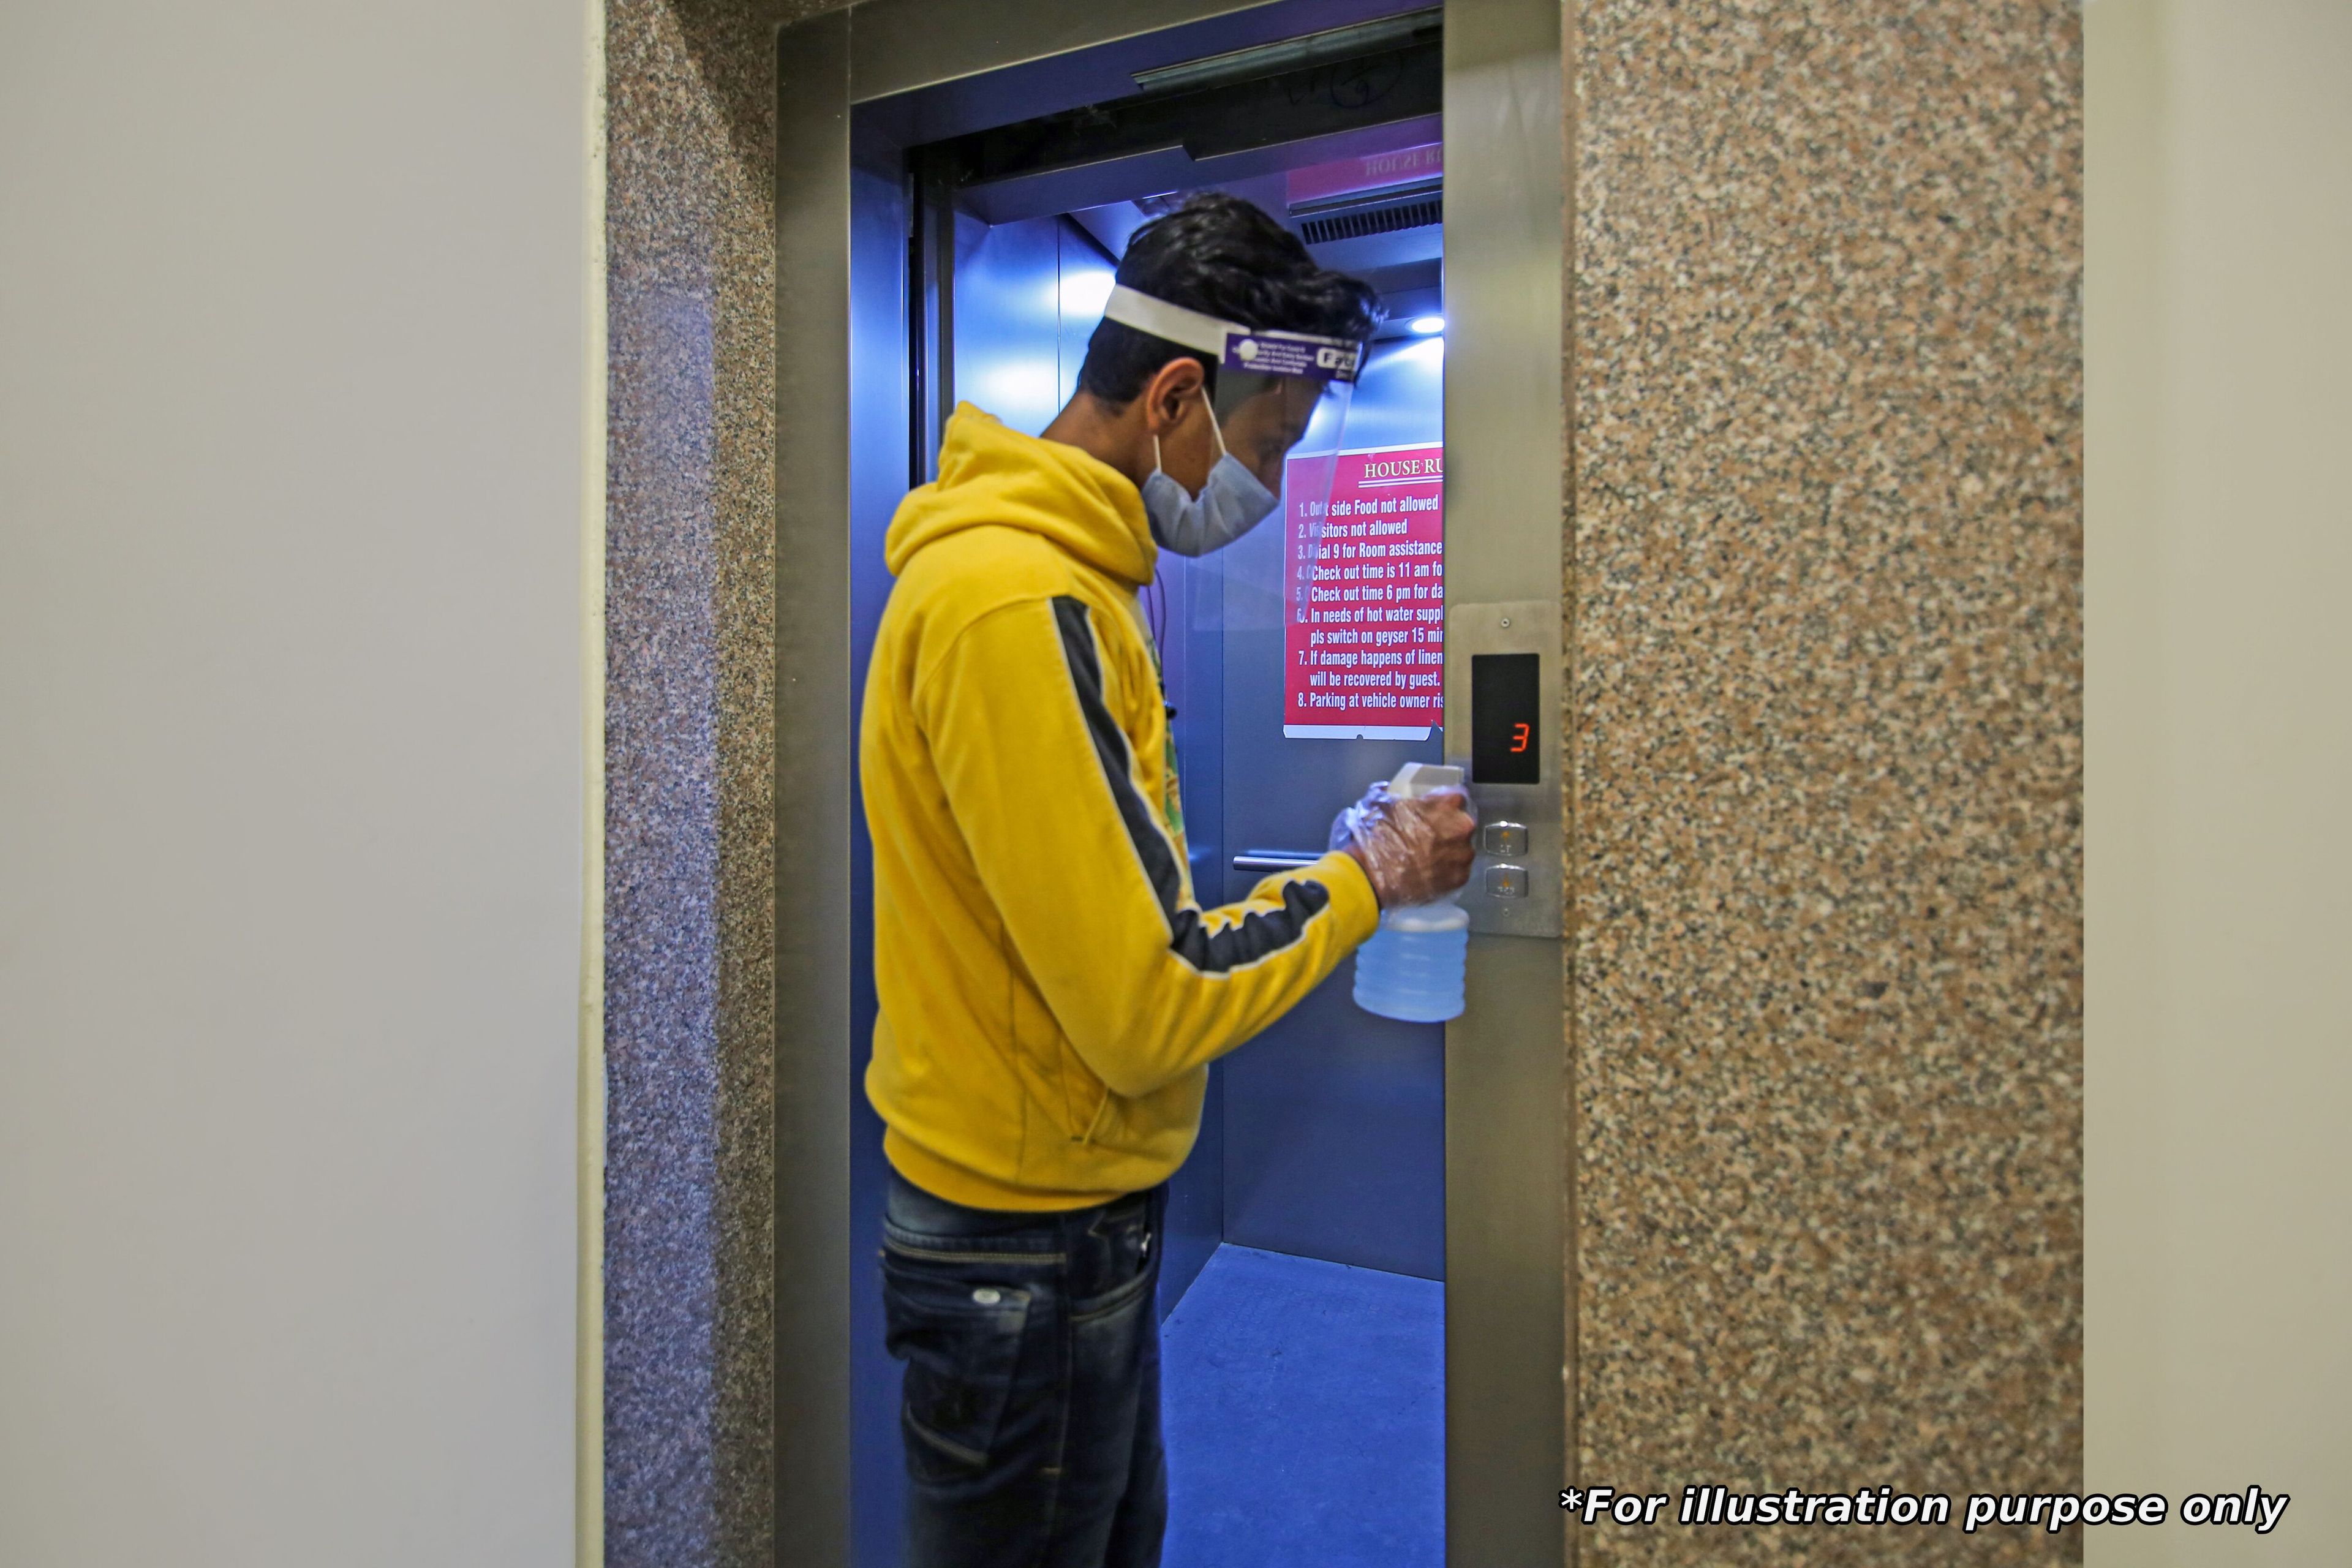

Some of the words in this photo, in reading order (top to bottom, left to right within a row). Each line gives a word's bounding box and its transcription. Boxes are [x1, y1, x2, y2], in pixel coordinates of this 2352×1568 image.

[1364, 459, 1420, 478] HOUSE
[1299, 502, 1307, 517] 1.
[1332, 500, 1351, 516] side
[1354, 499, 1378, 515] Food
[1381, 498, 1396, 513] not
[1400, 494, 1438, 512] allowed
[1298, 524, 1306, 538] 2.
[1309, 522, 1348, 538] Visitors
[1351, 521, 1366, 537] not
[1370, 518, 1408, 536] allowed
[1298, 545, 1305, 559] 3.
[1308, 544, 1330, 559] Dial
[1333, 543, 1340, 559] 9
[1343, 543, 1356, 558] for
[1359, 542, 1386, 557] Room
[1389, 540, 1442, 556] assistance
[1297, 566, 1304, 581] 4.
[1312, 564, 1341, 581] Check
[1344, 564, 1359, 579] out
[1362, 564, 1384, 579] time
[1387, 563, 1395, 578] is
[1398, 562, 1410, 577] 11
[1414, 565, 1429, 577] am
[1296, 587, 1303, 601] 5.
[1311, 586, 1341, 602] Check
[1344, 586, 1359, 601] out
[1362, 586, 1383, 600] time
[1386, 585, 1393, 600] 6
[1396, 588, 1411, 603] pm
[1414, 584, 1428, 599] for
[1311, 608, 1320, 623] In
[1323, 608, 1351, 622] needs
[1354, 608, 1364, 622] of
[1367, 607, 1382, 622] hot
[1385, 607, 1414, 622] water
[1311, 629, 1324, 647] pls
[1327, 628, 1358, 644] switch
[1361, 631, 1373, 644] on
[1376, 630, 1408, 647] geyser
[1412, 627, 1424, 643] 15
[1298, 650, 1308, 665] 7.
[1311, 650, 1317, 665] If
[1321, 650, 1357, 668] damage
[1361, 650, 1402, 668] happens
[1405, 649, 1415, 665] of
[1418, 649, 1443, 665] linen
[1310, 671, 1326, 687] will
[1330, 671, 1341, 686] be
[1344, 671, 1392, 686] recovered
[1395, 671, 1406, 689] by
[1409, 671, 1440, 690] guest.
[1298, 692, 1306, 707] 8.
[1310, 692, 1346, 710] Parking
[1349, 693, 1359, 707] at
[1362, 692, 1396, 707] vehicle
[1400, 696, 1430, 708] owner
[1510, 723, 1529, 752] 3
